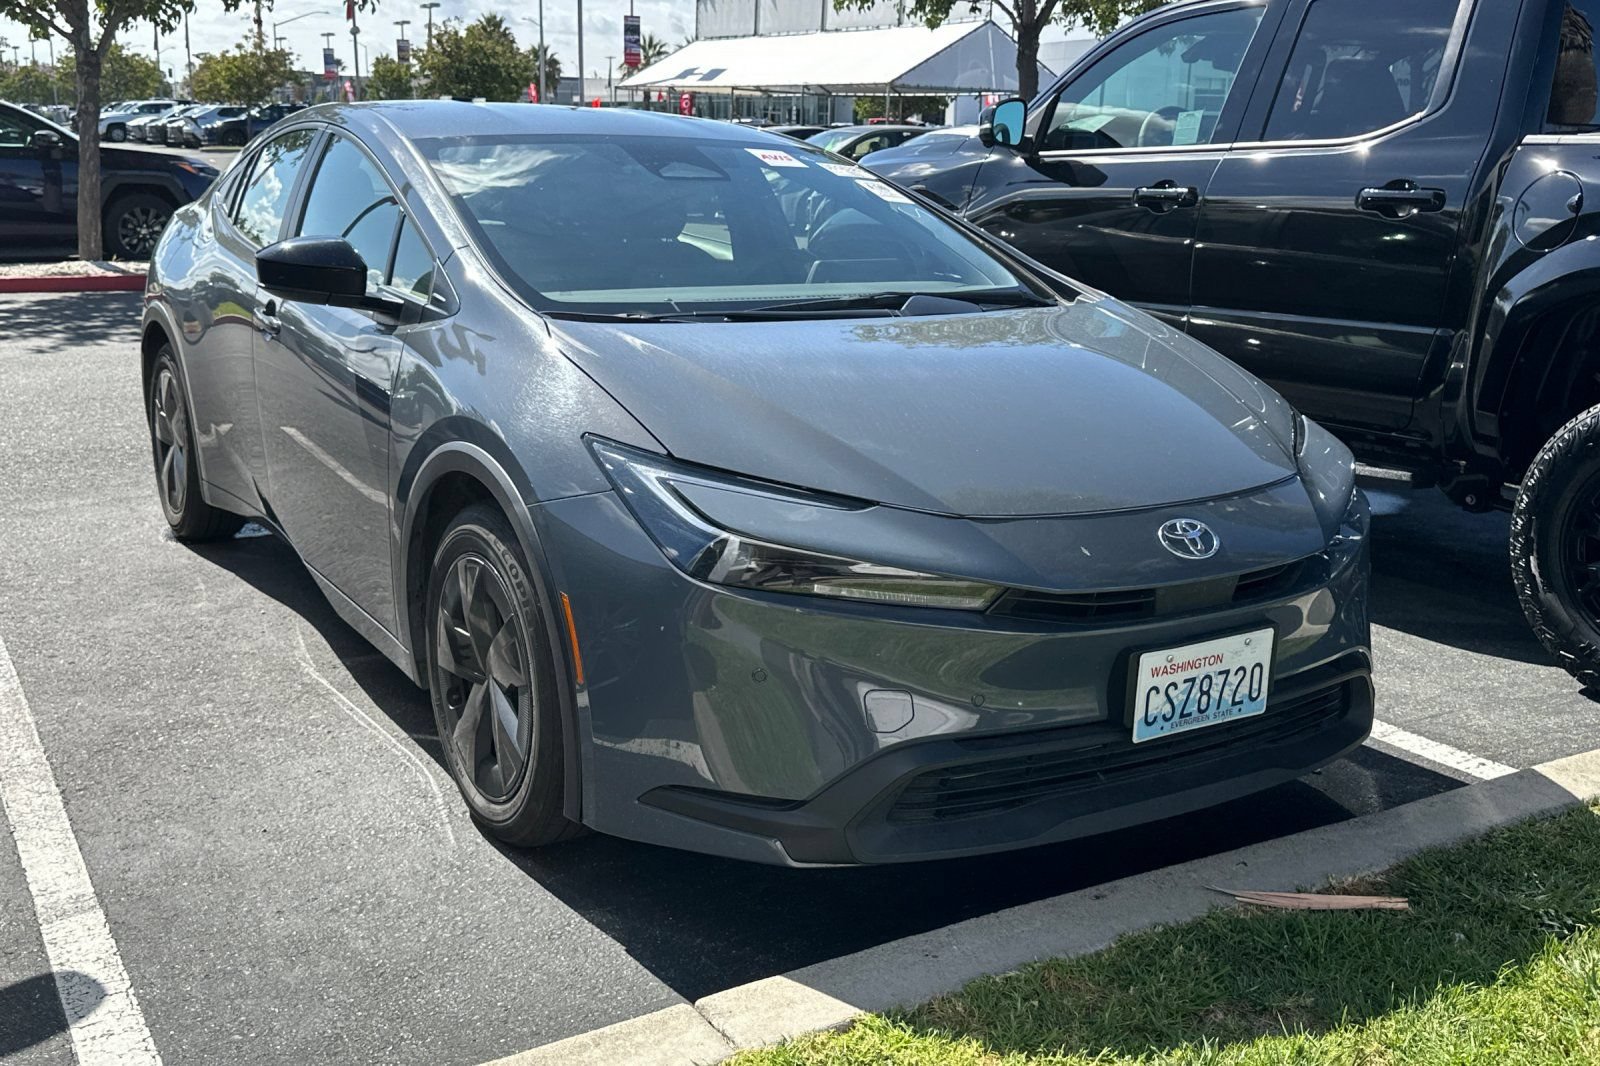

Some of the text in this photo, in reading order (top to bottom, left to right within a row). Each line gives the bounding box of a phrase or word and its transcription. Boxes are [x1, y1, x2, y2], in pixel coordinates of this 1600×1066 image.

[1151, 654, 1223, 678] WASHINGTON
[1144, 662, 1264, 727] CSZ8720
[1170, 708, 1233, 729] EVERGREEN STATE
